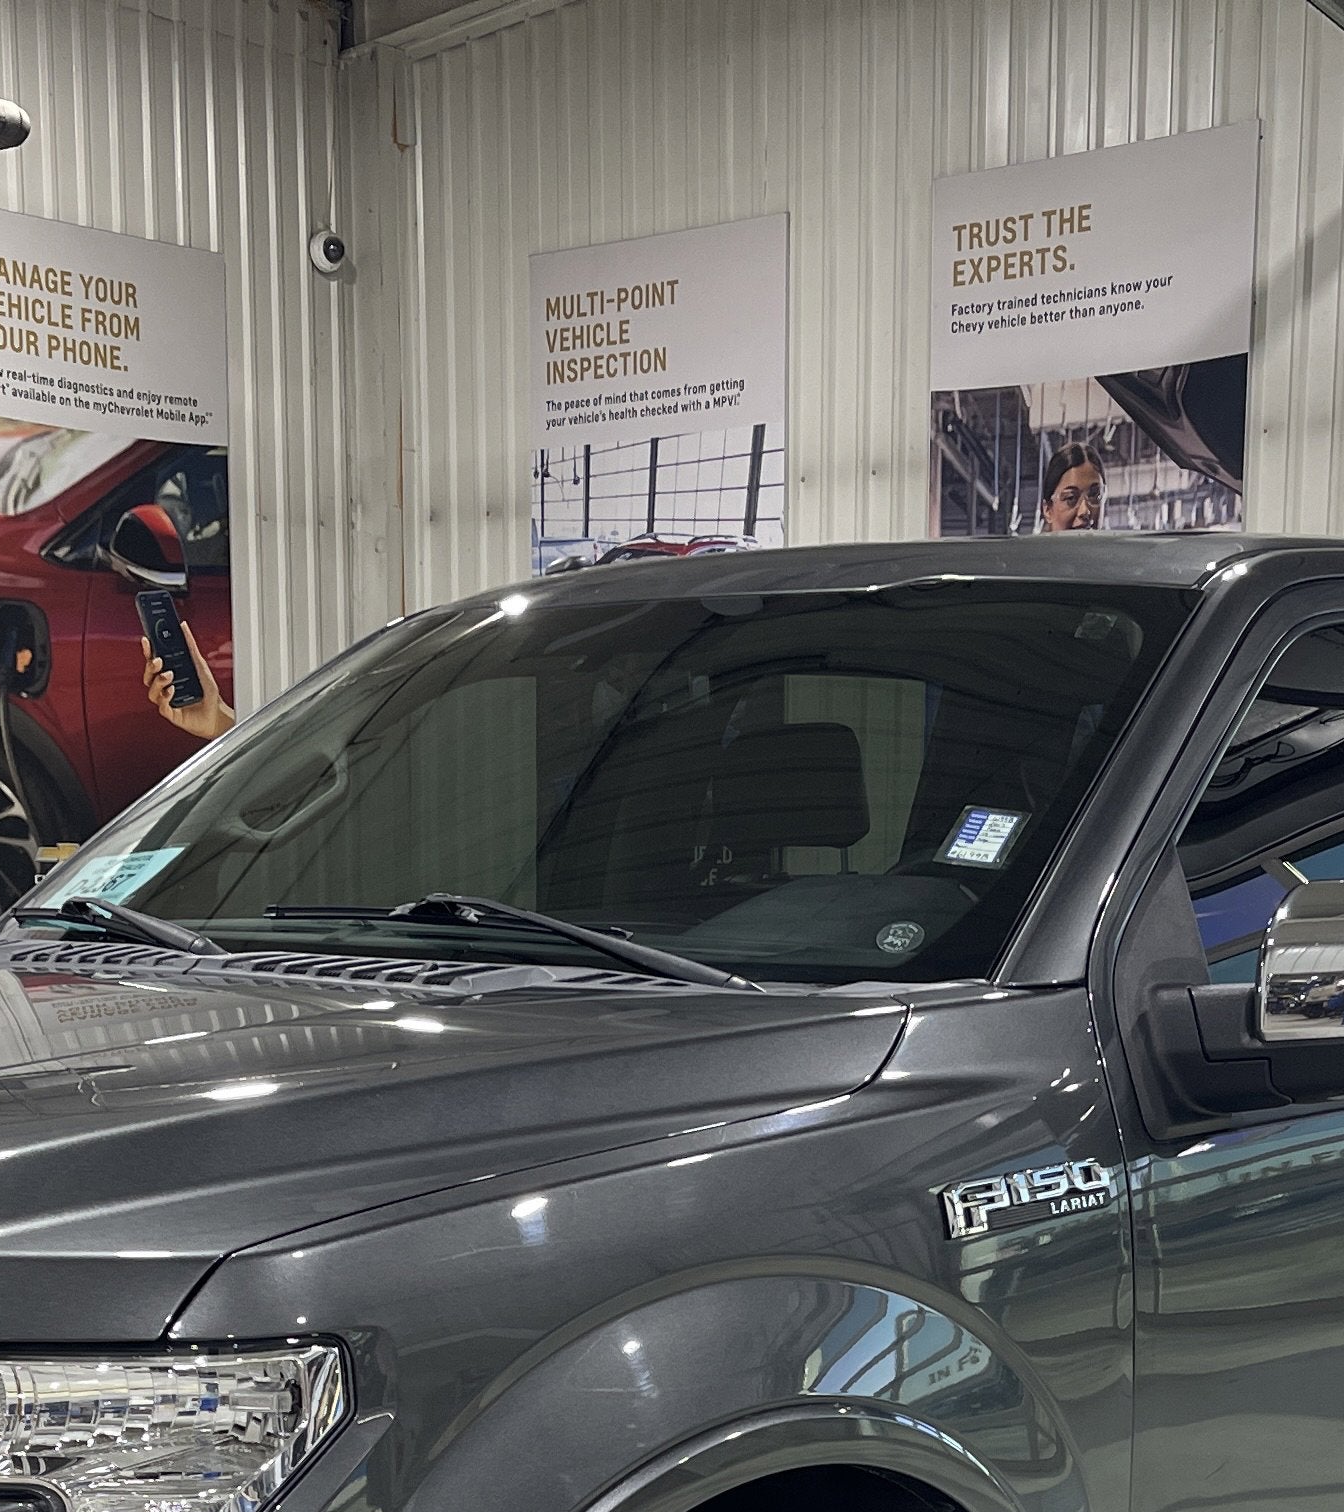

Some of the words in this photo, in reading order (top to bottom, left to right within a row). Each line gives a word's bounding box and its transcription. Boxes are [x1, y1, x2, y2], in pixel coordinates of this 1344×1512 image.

[953, 213, 1034, 252] TRUST
[1042, 203, 1092, 238] THE
[953, 245, 1076, 287] EXPERTS.
[79, 273, 138, 309] YOUR
[545, 279, 679, 322] MULTI-POINT
[951, 300, 994, 317] Factory
[997, 293, 1038, 311] trained
[1040, 286, 1107, 306] technicians
[1110, 281, 1142, 296] know
[1145, 274, 1174, 293] your
[80, 307, 141, 342] FROM
[951, 319, 985, 335] Chevy
[987, 314, 1027, 330] vehicle
[1029, 309, 1066, 324] better
[1069, 305, 1096, 321] than
[1098, 299, 1145, 317] anyone.
[47, 334, 129, 372] PHONE.
[545, 319, 631, 354] VEHICLE
[546, 346, 667, 385] INSPECTION
[6, 369, 55, 387] real-time
[57, 377, 114, 397] diagnostics
[116, 387, 135, 401] and
[137, 391, 162, 406] enjoy
[164, 394, 198, 408] remote
[11, 386, 56, 404] available
[59, 396, 72, 407] on
[73, 395, 90, 410] the
[93, 401, 154, 419] myChevrolet
[156, 408, 186, 423] Mobile
[546, 400, 562, 412] The
[564, 398, 591, 413] peace
[593, 394, 603, 406] of
[605, 392, 627, 405] mind
[629, 390, 649, 402] that
[651, 387, 682, 400] comes
[683, 383, 707, 397] from
[709, 378, 745, 395] getting
[545, 416, 566, 430] your
[568, 410, 607, 426] vehicle's
[609, 407, 638, 421] health
[640, 403, 679, 418] checked
[680, 399, 702, 413] with
[704, 401, 711, 410] a
[1050, 1192, 1106, 1214] LARIAT
